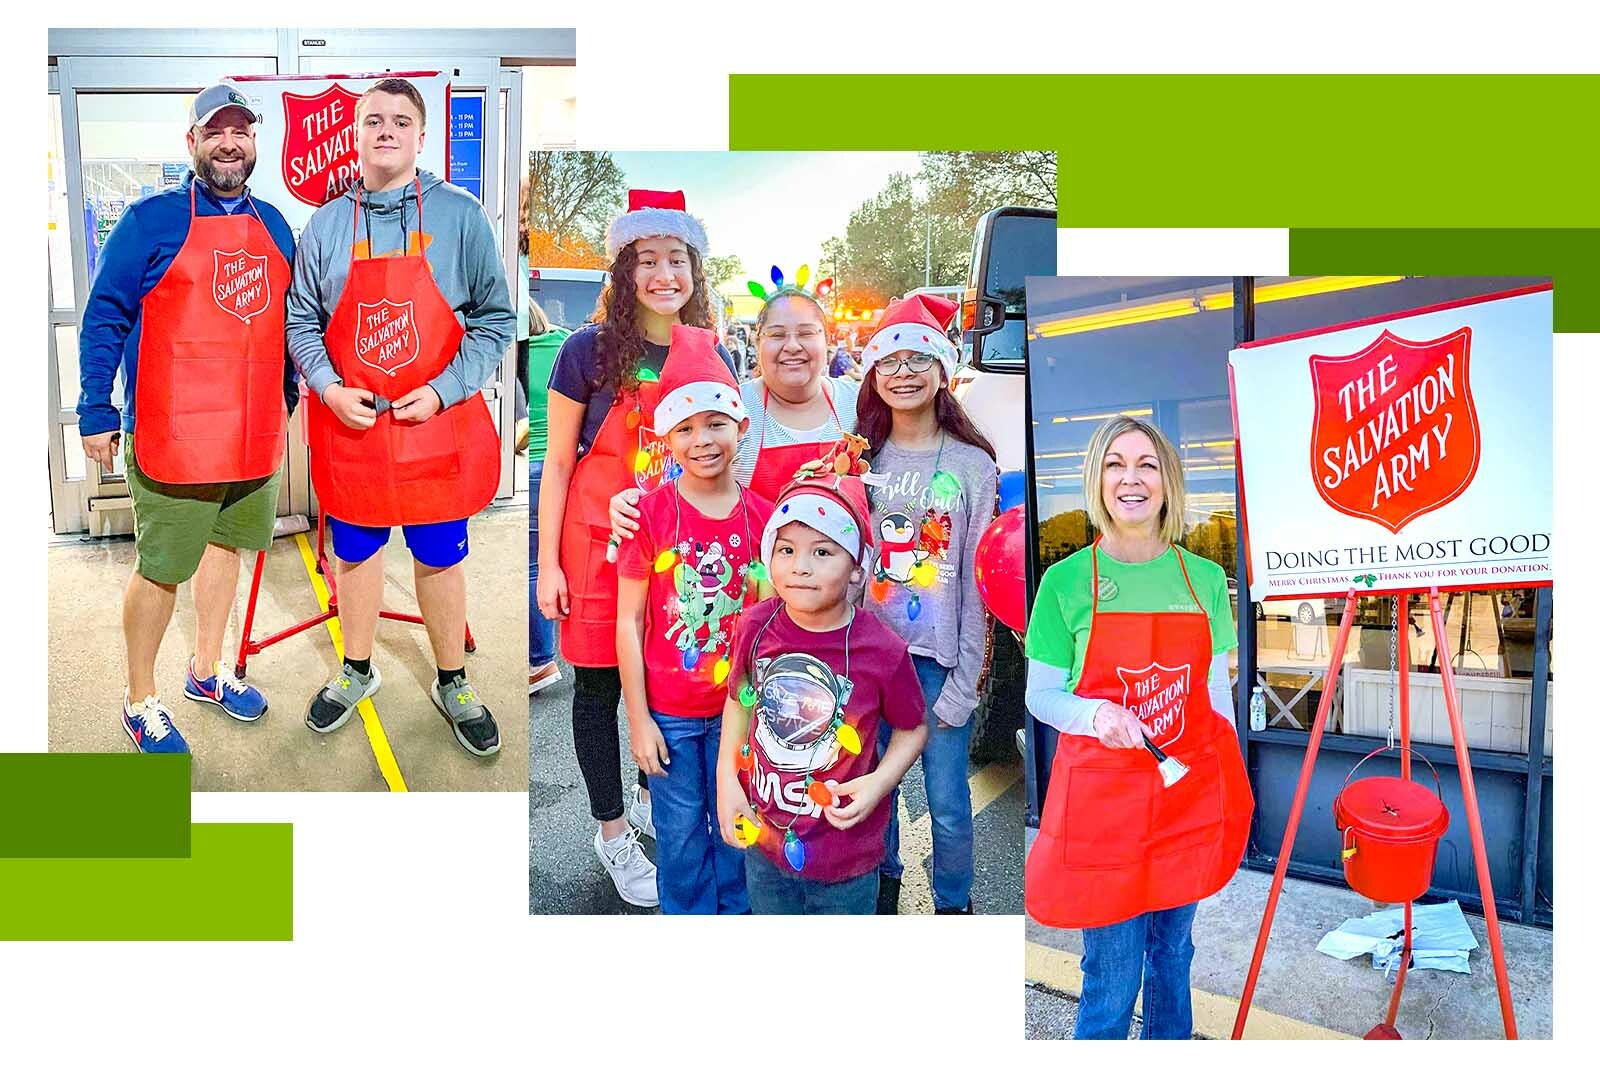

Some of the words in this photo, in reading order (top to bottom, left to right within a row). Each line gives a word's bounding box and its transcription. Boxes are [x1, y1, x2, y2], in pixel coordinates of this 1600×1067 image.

[302, 99, 345, 142] THE
[290, 122, 359, 186] SALVATI
[325, 159, 364, 201] ARM
[217, 263, 263, 301] SALVATION
[223, 257, 247, 277] THE
[234, 281, 263, 311] ARMY
[360, 309, 410, 355] SALVATION
[366, 307, 390, 330] THE
[377, 329, 410, 365] ARMY
[1338, 354, 1399, 423] THE
[1323, 353, 1456, 489] SALVATION
[649, 440, 666, 457] TH
[1371, 412, 1453, 511] ARMY
[1265, 548, 1340, 570] DOING
[1343, 545, 1389, 565] THE
[1395, 539, 1463, 562] MOST
[1469, 533, 1551, 556] GOOD
[1413, 569, 1435, 579] YOU
[1437, 568, 1458, 578] FOR
[1459, 566, 1489, 577] YOUR
[1491, 563, 1552, 574] DONATION.
[1134, 673, 1160, 698] THE
[1148, 699, 1183, 736] RMY
